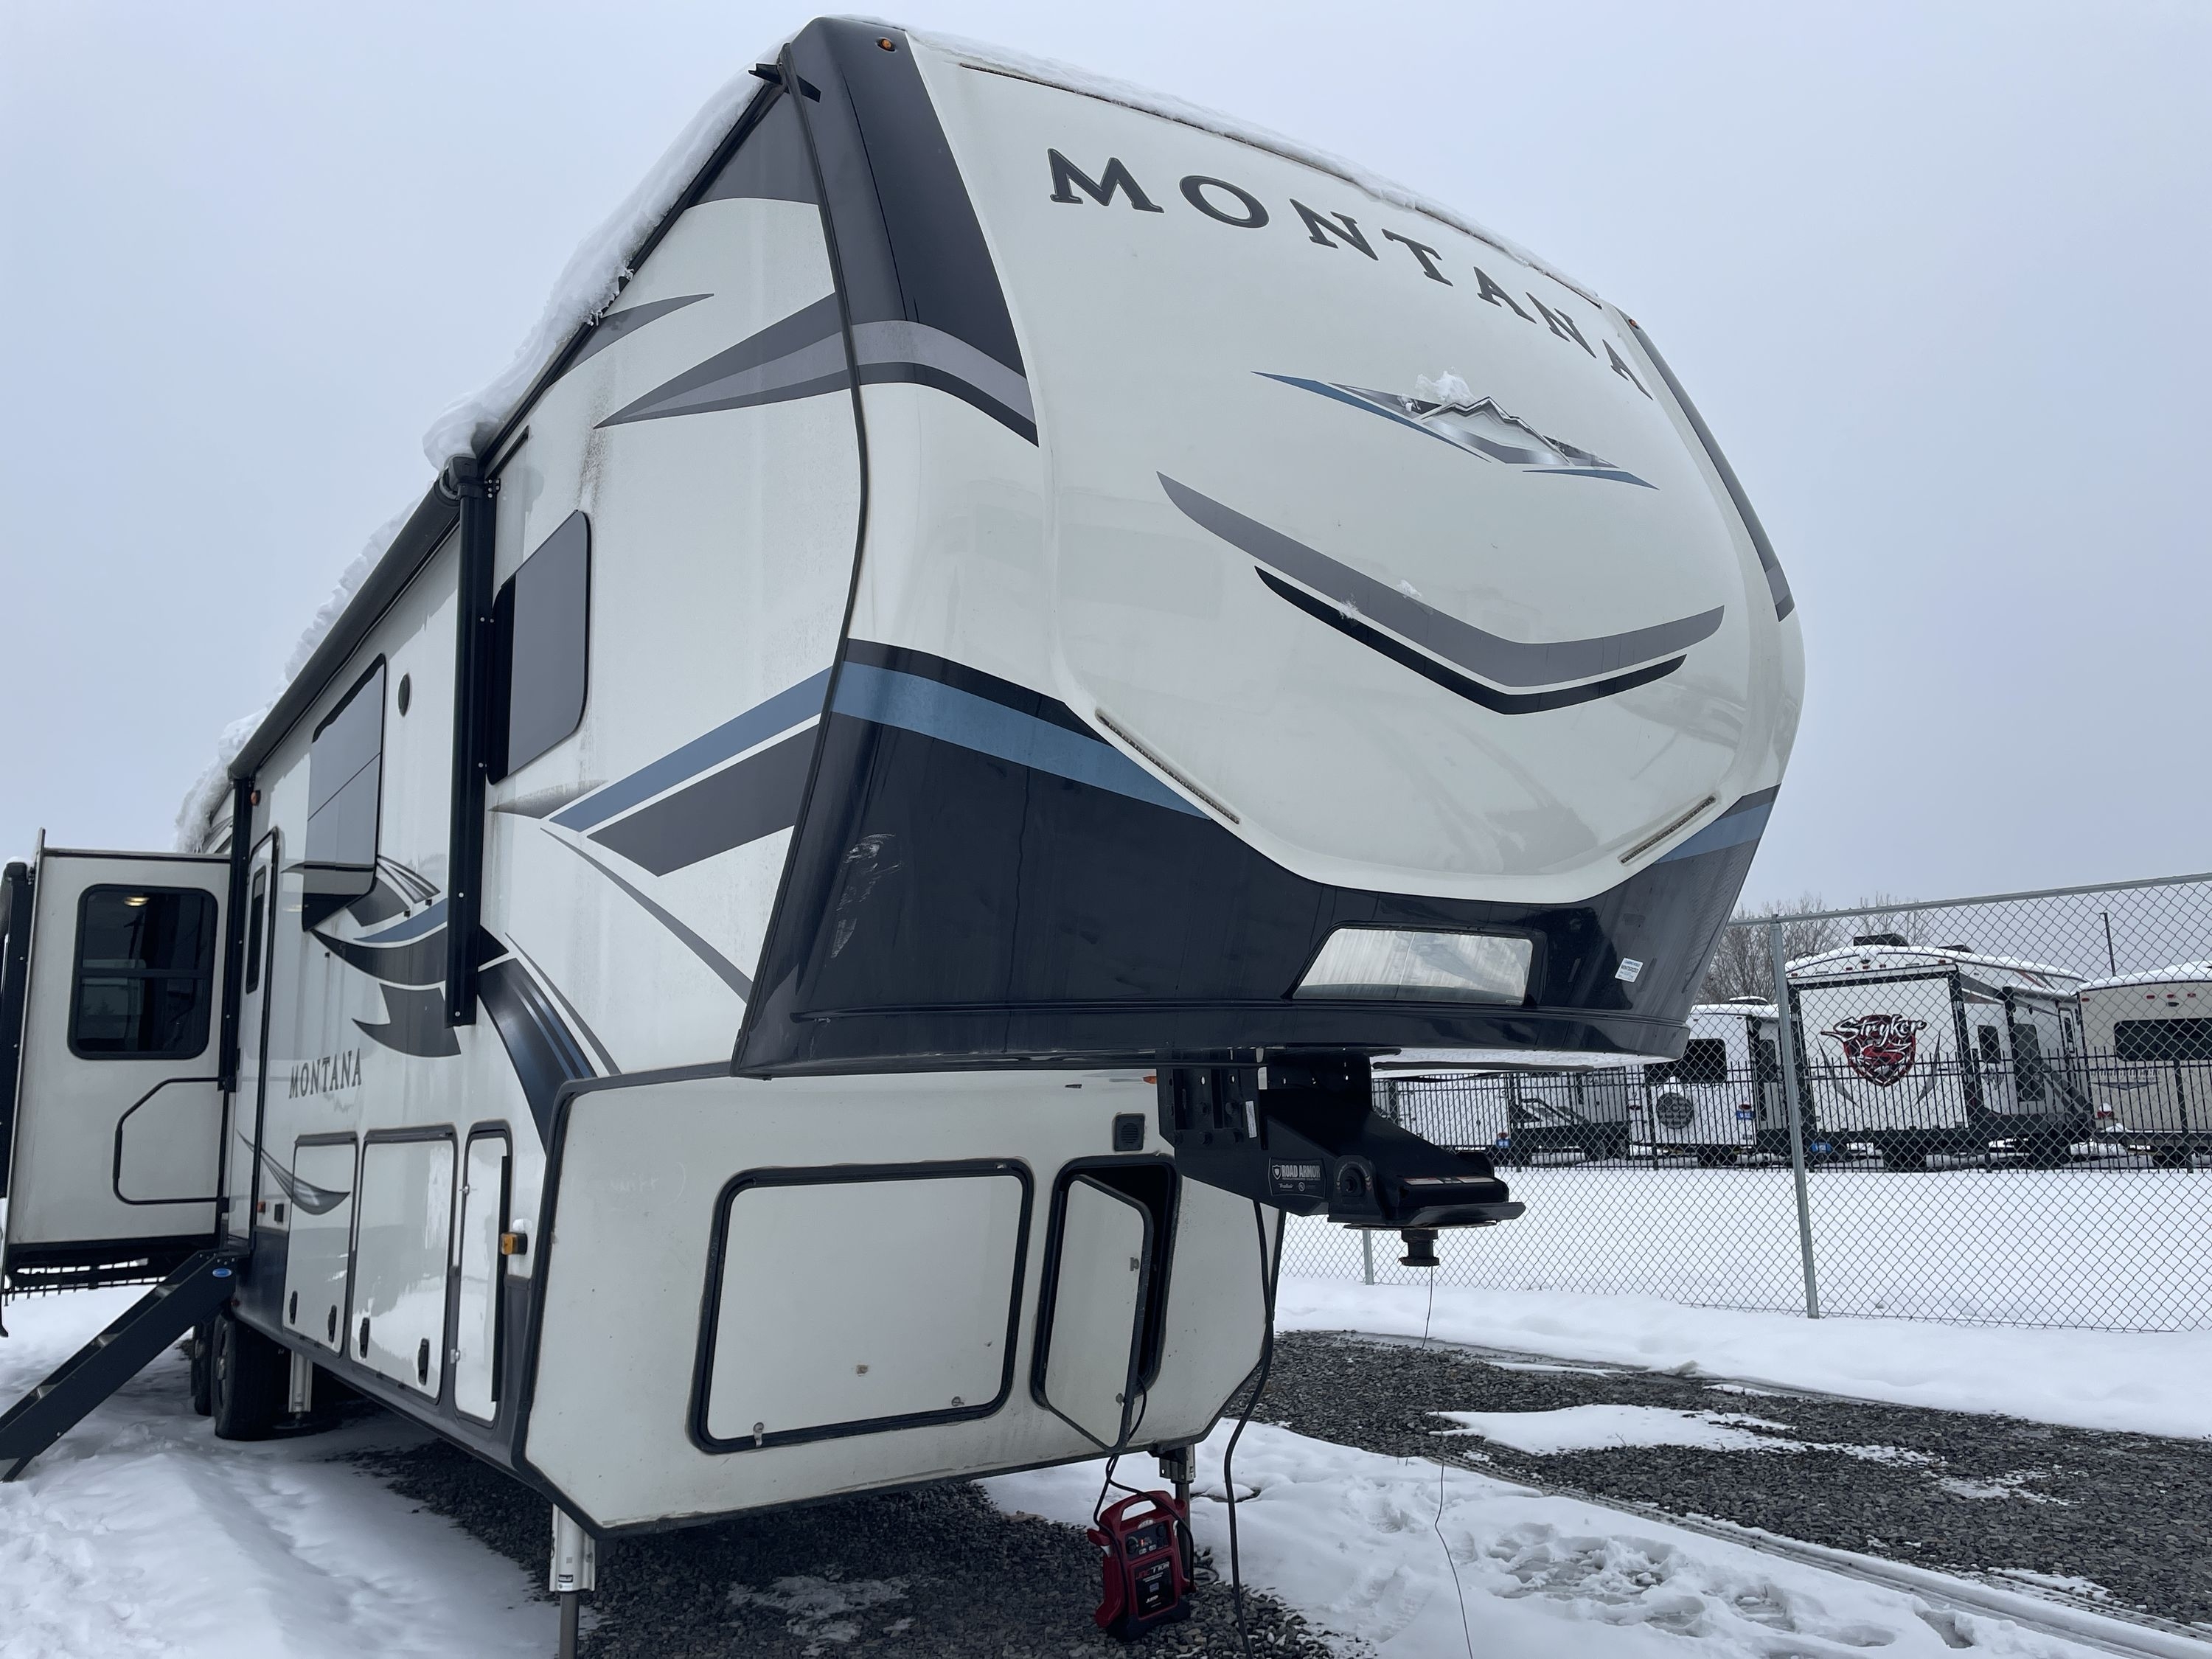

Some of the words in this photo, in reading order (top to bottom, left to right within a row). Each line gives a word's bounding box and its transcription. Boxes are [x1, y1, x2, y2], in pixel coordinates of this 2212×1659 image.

[1046, 147, 1654, 401] MONTANA
[1820, 1014, 1927, 1047] Stryker
[288, 1046, 362, 1099] MONTANA
[1281, 1164, 1298, 1178] ROAD
[1298, 1165, 1321, 1178] ARMOR
